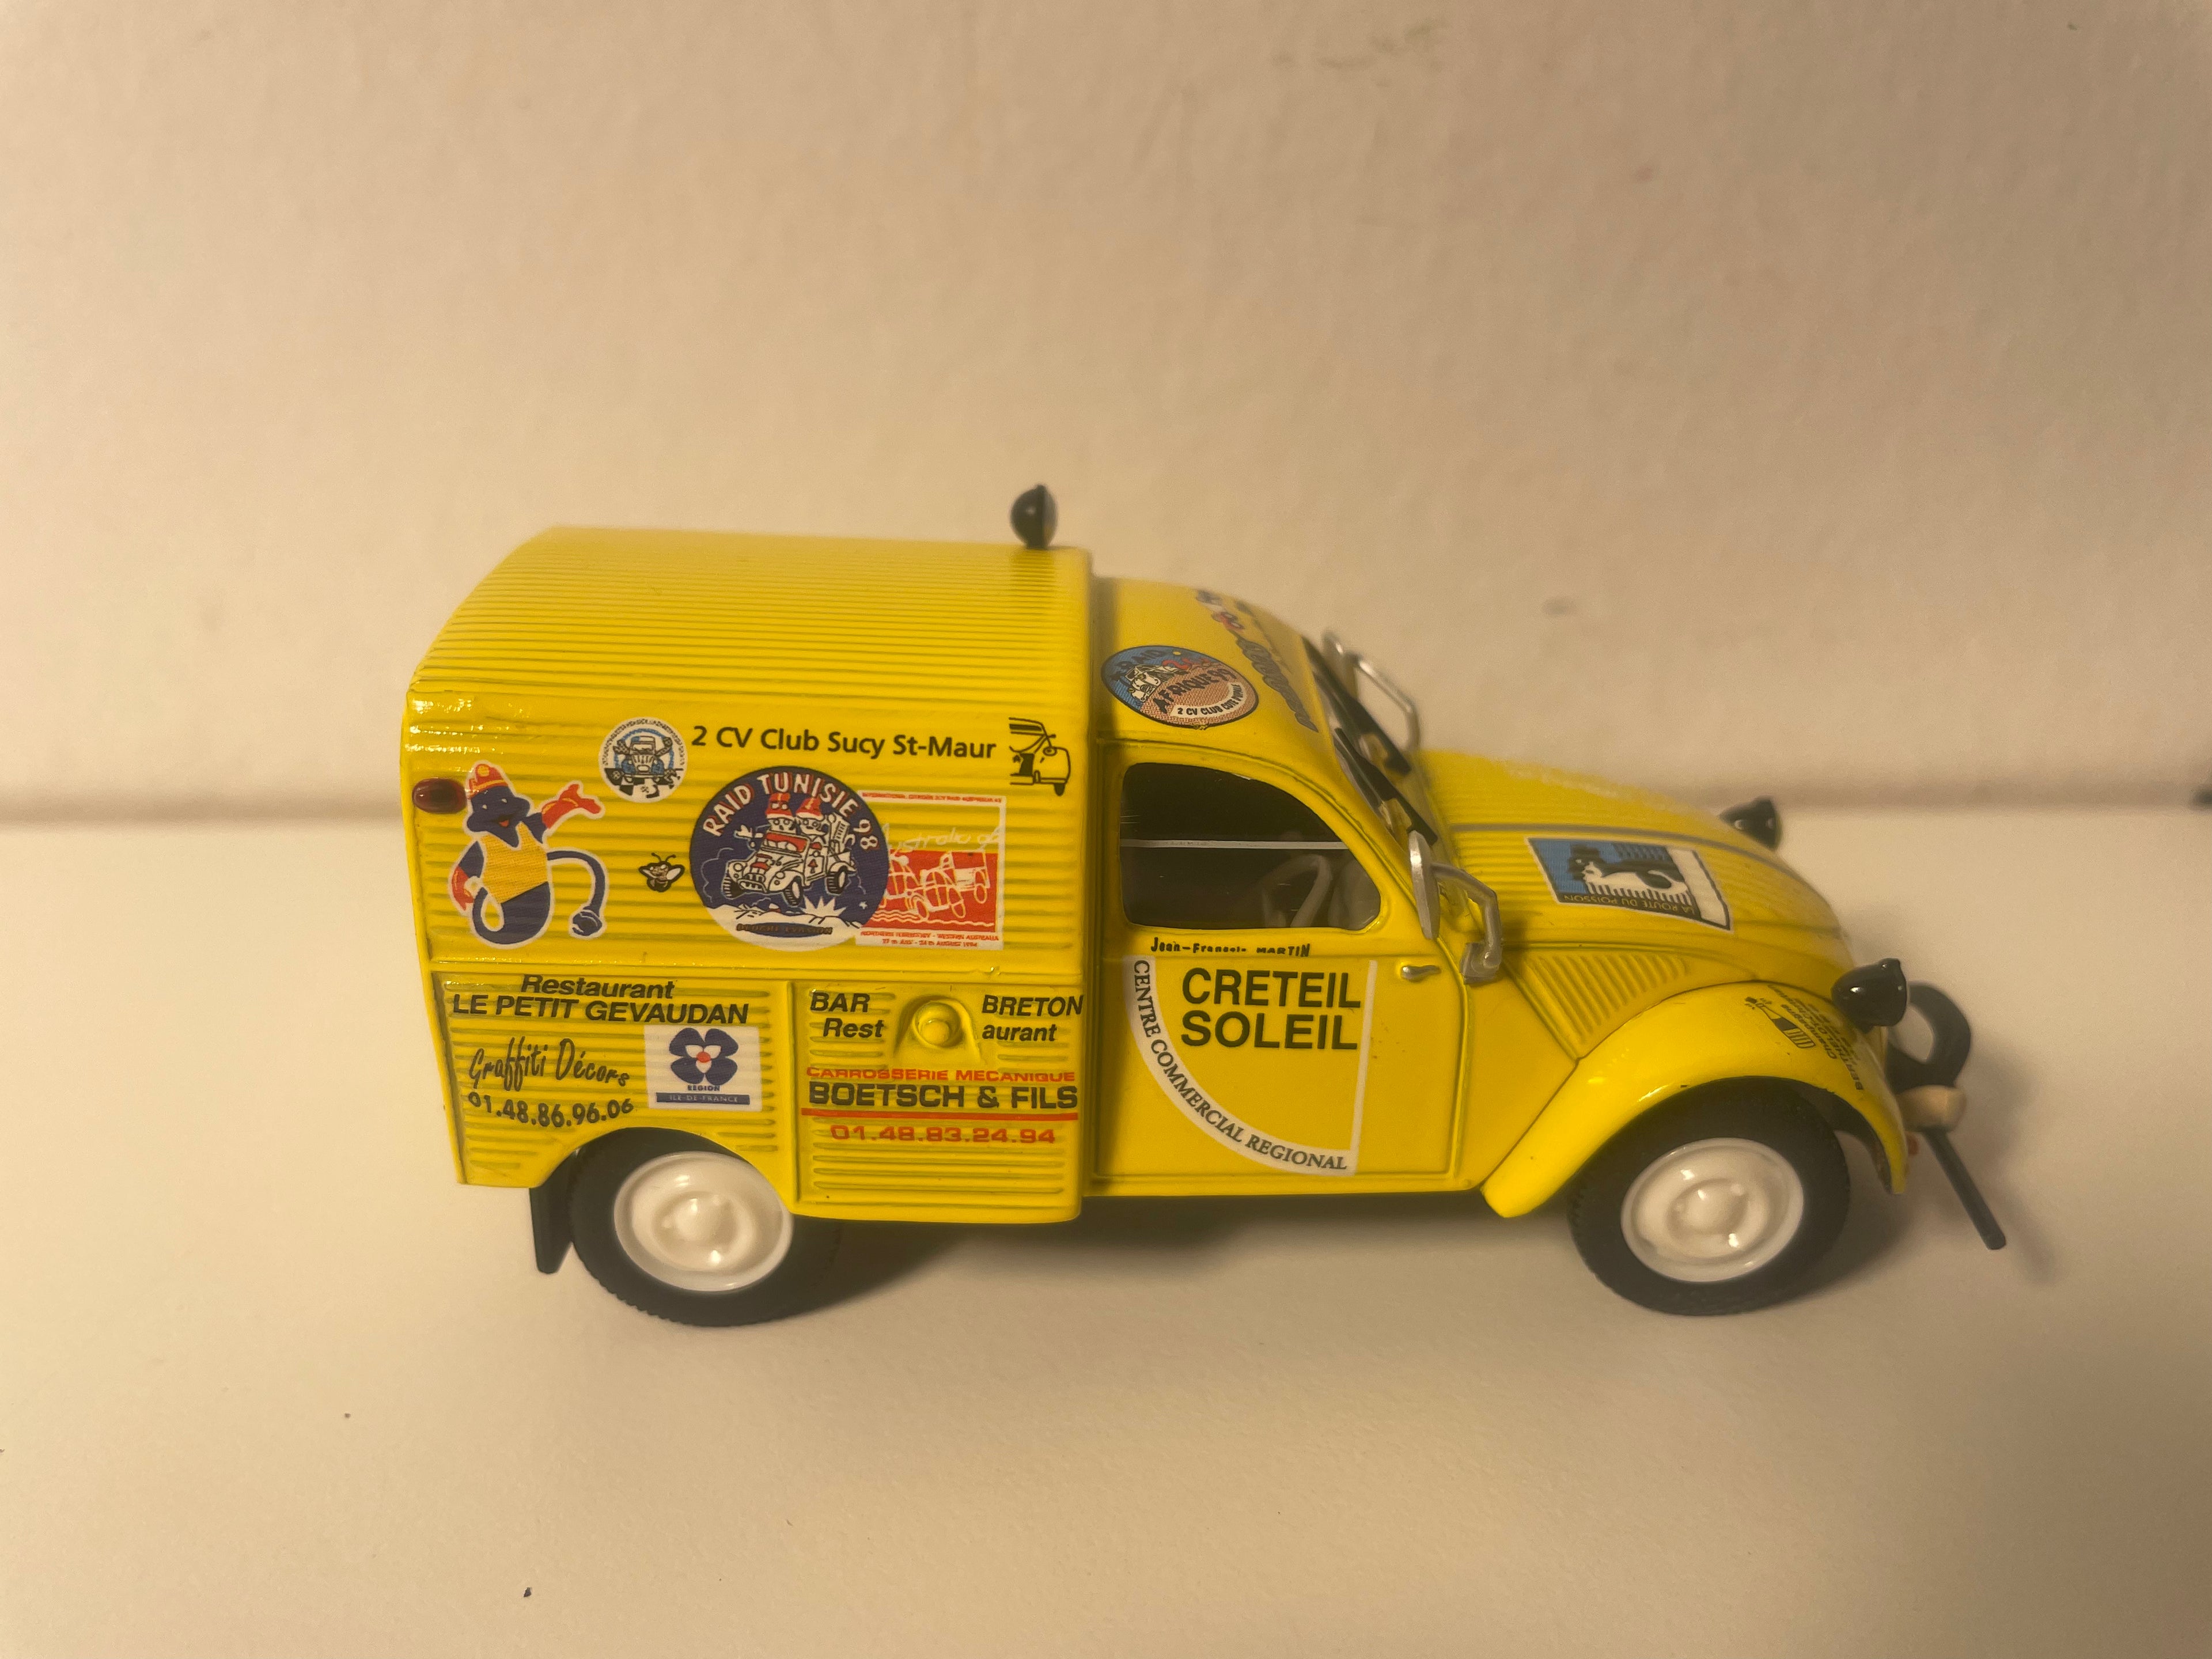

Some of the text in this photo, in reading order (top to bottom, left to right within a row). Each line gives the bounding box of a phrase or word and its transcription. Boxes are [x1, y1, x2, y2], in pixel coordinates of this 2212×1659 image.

[1200, 705, 1224, 715] CLUB
[691, 725, 707, 747] 2
[718, 727, 753, 749] CV
[761, 728, 819, 752] Club
[828, 732, 885, 759] Sucy
[892, 735, 997, 759] St-Maur
[703, 772, 880, 850] RAID TUNISIE 98
[1564, 895, 1618, 904] POISSON
[1622, 898, 1638, 907] DU
[1642, 900, 1677, 912] ROUTE
[1256, 943, 1311, 957] MARTIN
[521, 974, 675, 999] Restaurant
[1182, 968, 1361, 1008] CRETEIL
[453, 994, 749, 1024] LE PETIT GEVAUDAN
[810, 993, 1084, 1017] BAR BRETON
[823, 1018, 1057, 1042] Rest aurant
[1181, 1010, 1358, 1050] SOLEIL
[468, 1036, 630, 1091] Graffiti Décors
[806, 1067, 1075, 1082] CARROSSERIE MECANIQUE
[1133, 960, 1347, 1171] CENTRE COMMERCIAL REGIONAL
[809, 1081, 1078, 1109] BOETSCH & FILS
[468, 1092, 633, 1127] 01.48.86.96.06
[830, 1125, 1055, 1144] 01.48.83.24.94
